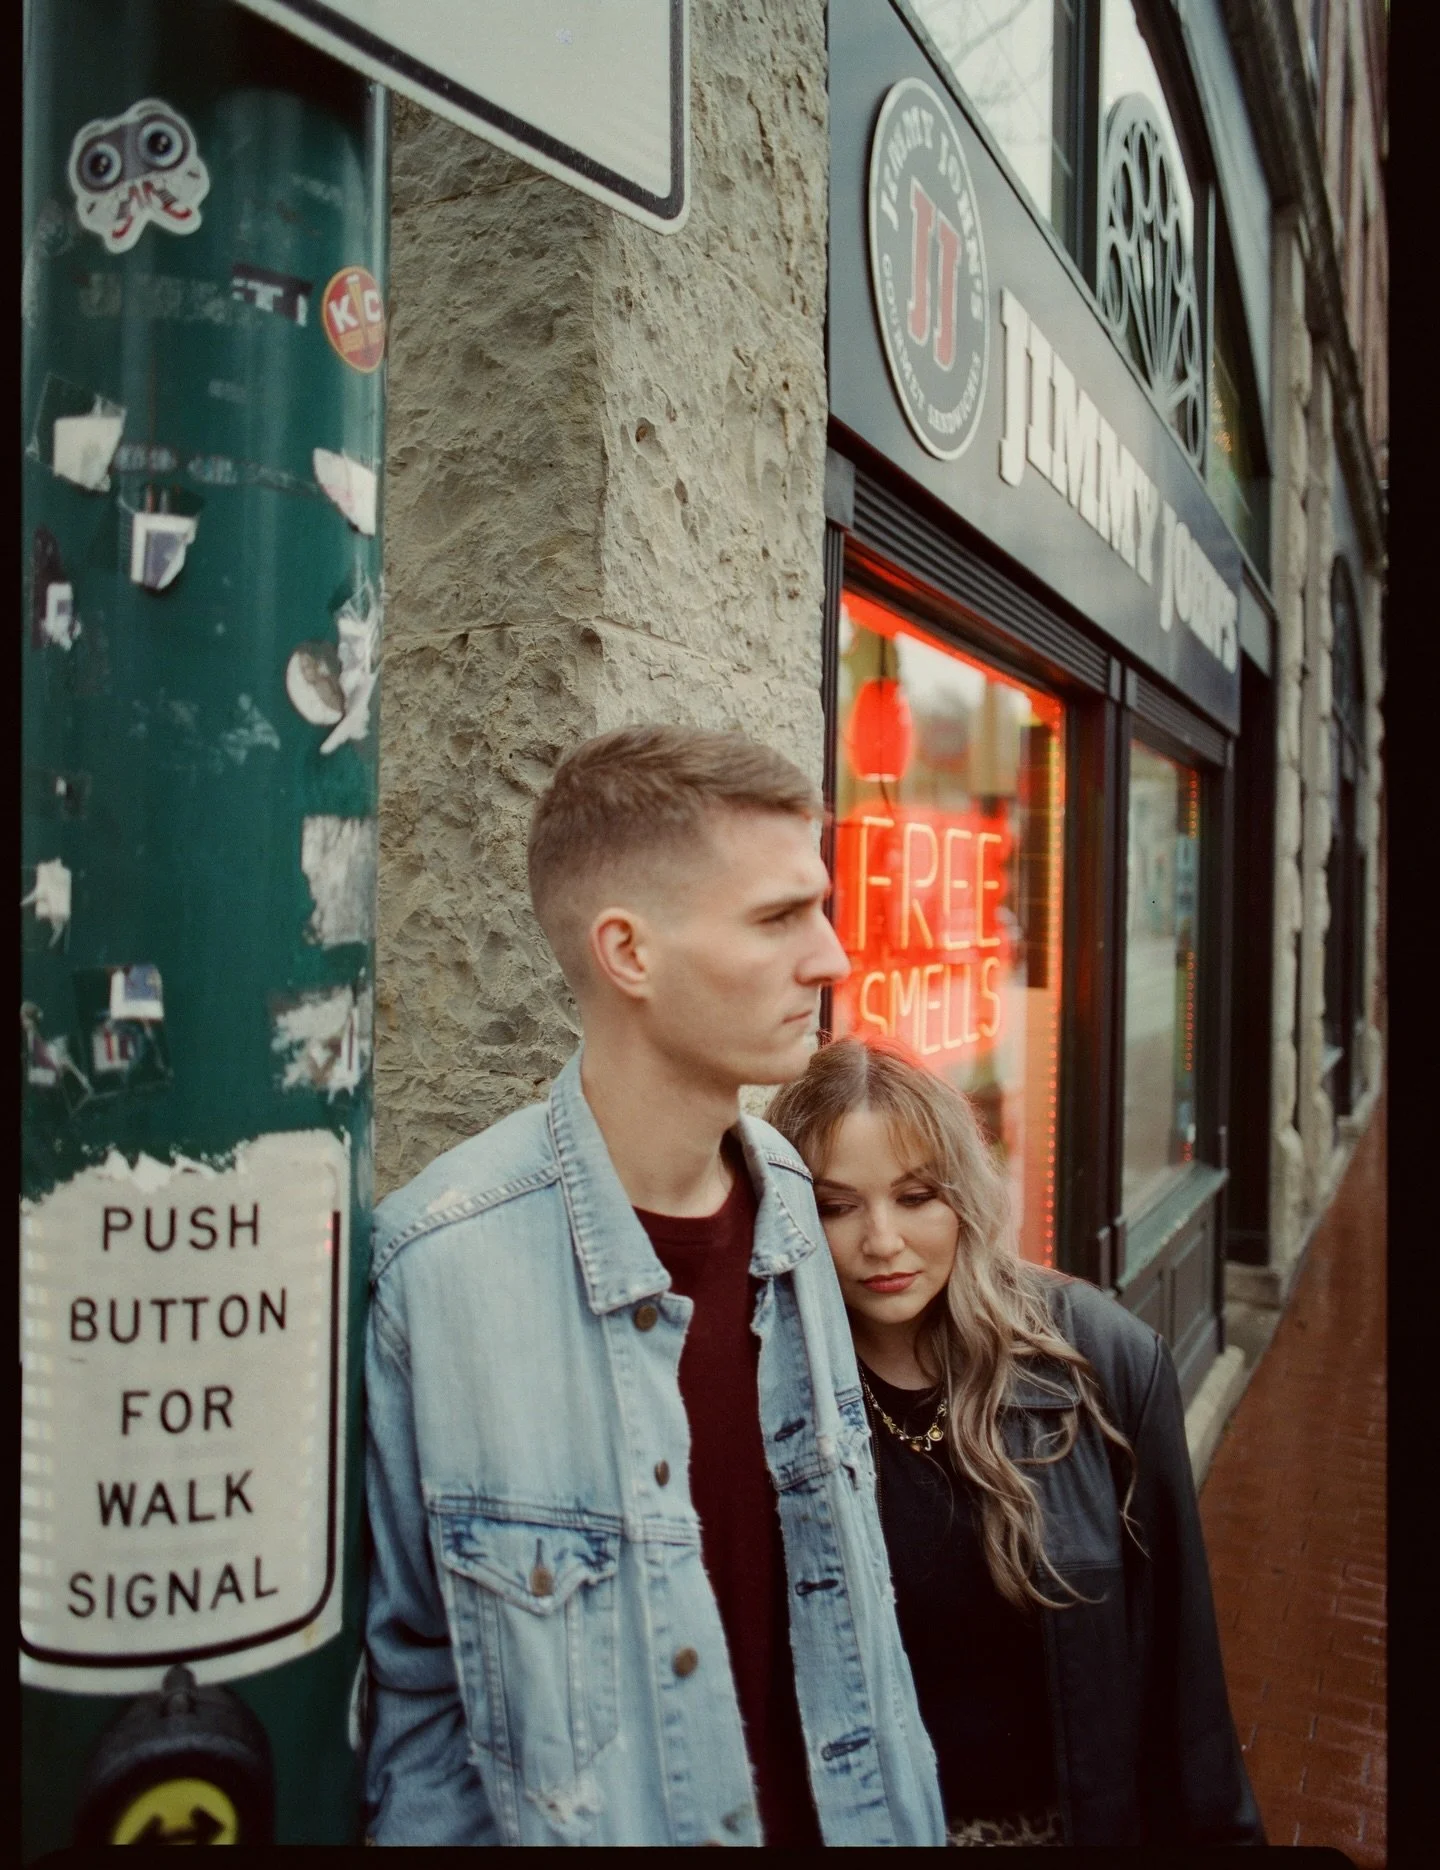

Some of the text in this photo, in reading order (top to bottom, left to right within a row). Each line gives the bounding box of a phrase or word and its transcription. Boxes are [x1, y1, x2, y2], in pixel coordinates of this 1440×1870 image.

[999, 285, 1159, 588] JIMMY
[858, 816, 1002, 950] FREE
[859, 957, 1001, 1055] SMELLS
[102, 1202, 260, 1252] PUSH
[70, 1287, 288, 1344] BUTTON
[120, 1385, 234, 1436] FOR
[97, 1469, 255, 1528] WALK
[67, 1556, 280, 1620] SIGNAL
